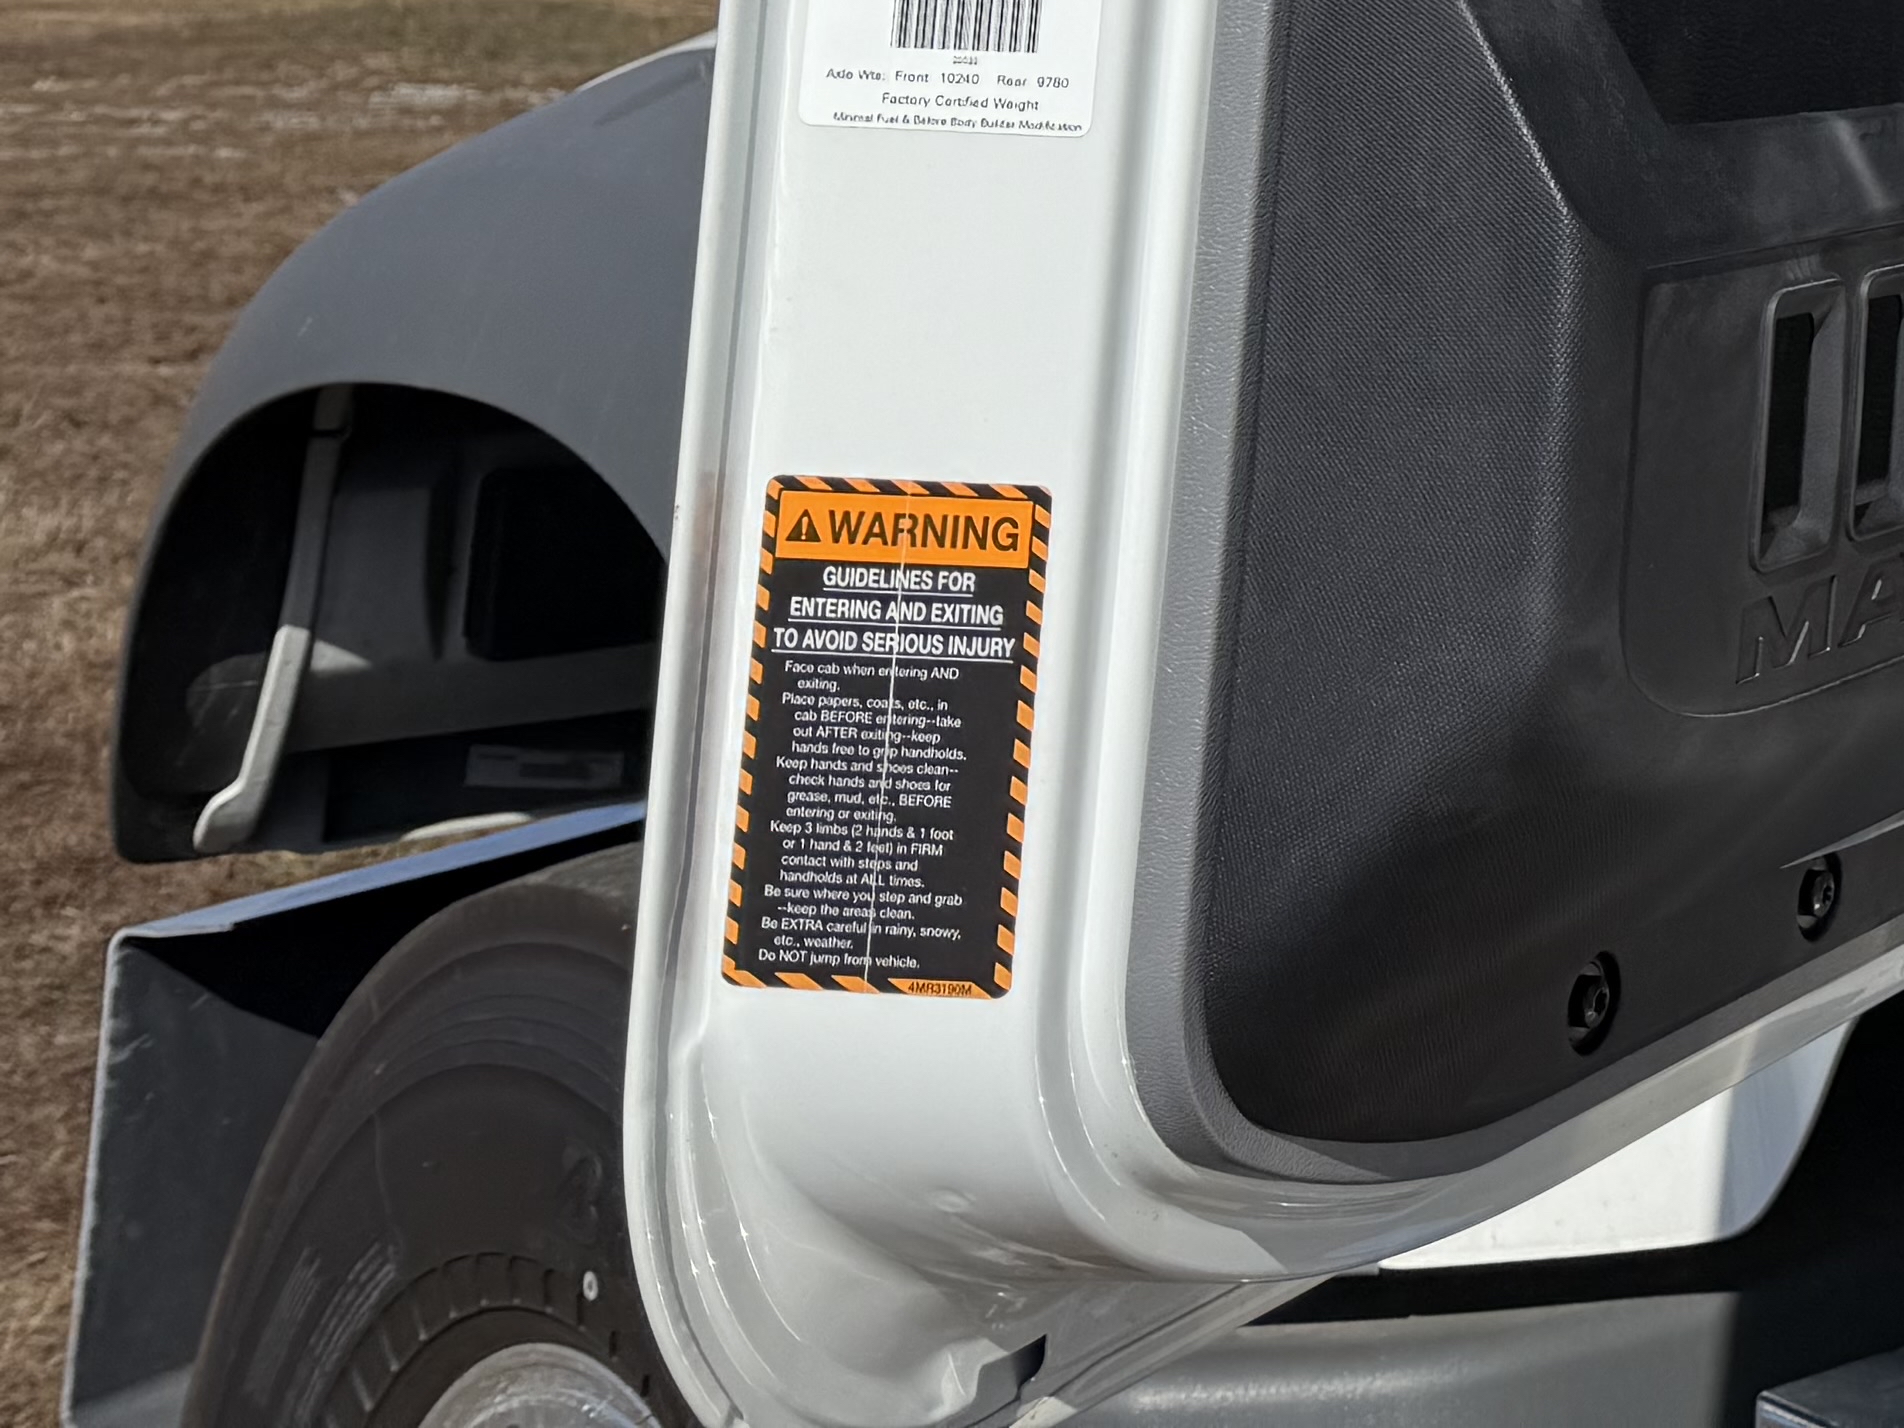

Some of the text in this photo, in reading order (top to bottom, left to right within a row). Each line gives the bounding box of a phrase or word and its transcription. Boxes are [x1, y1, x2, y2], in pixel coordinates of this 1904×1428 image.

[894, 69, 929, 83] Front
[940, 72, 980, 85] 10240
[881, 91, 931, 108] Factory
[828, 509, 1019, 552] WARNING
[822, 565, 976, 592] GUIDELINES FOR
[789, 595, 1003, 625] ENTERING AND EXITING
[772, 626, 1016, 658] TO AVOID SERIOUS INJURY
[784, 659, 959, 681] Face cab when entering AND
[796, 677, 840, 693] exiting.
[781, 691, 815, 706] Place
[817, 695, 863, 709] papers,
[936, 698, 948, 711] in
[793, 708, 818, 722] cab
[820, 709, 873, 724] BEFORE
[792, 725, 813, 737] out
[815, 724, 858, 739] AFTER
[791, 739, 829, 754] hands
[831, 741, 855, 755] free
[857, 744, 870, 756] to
[900, 745, 967, 761] handholds.
[769, 819, 954, 840] Keep 3 limbs (2 hands & 1 foot
[781, 837, 943, 856] or 1 hand & 2 feet) in FIRM
[757, 947, 920, 968] Do NOT jump from vehicle.
